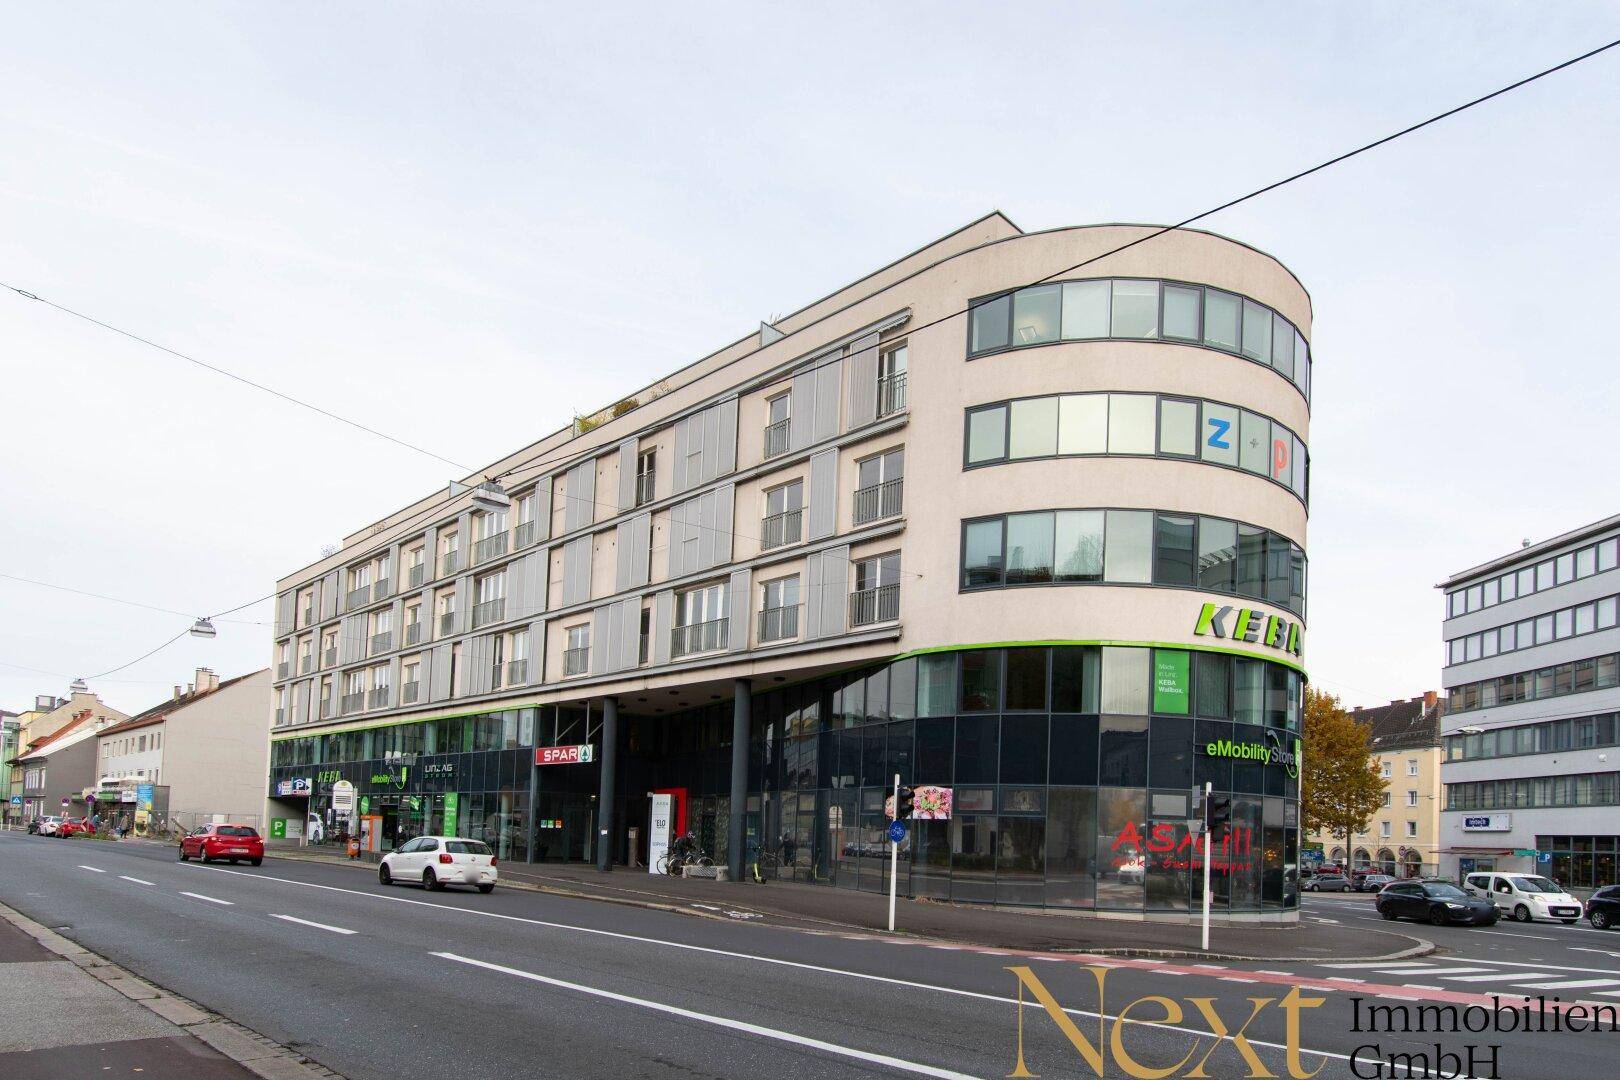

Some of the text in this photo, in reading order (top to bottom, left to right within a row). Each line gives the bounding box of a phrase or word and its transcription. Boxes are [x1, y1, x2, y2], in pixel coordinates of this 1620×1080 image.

[1194, 602, 1303, 657] KEBA
[543, 748, 578, 762] SPAR
[442, 763, 453, 772] AG
[274, 821, 283, 831] P
